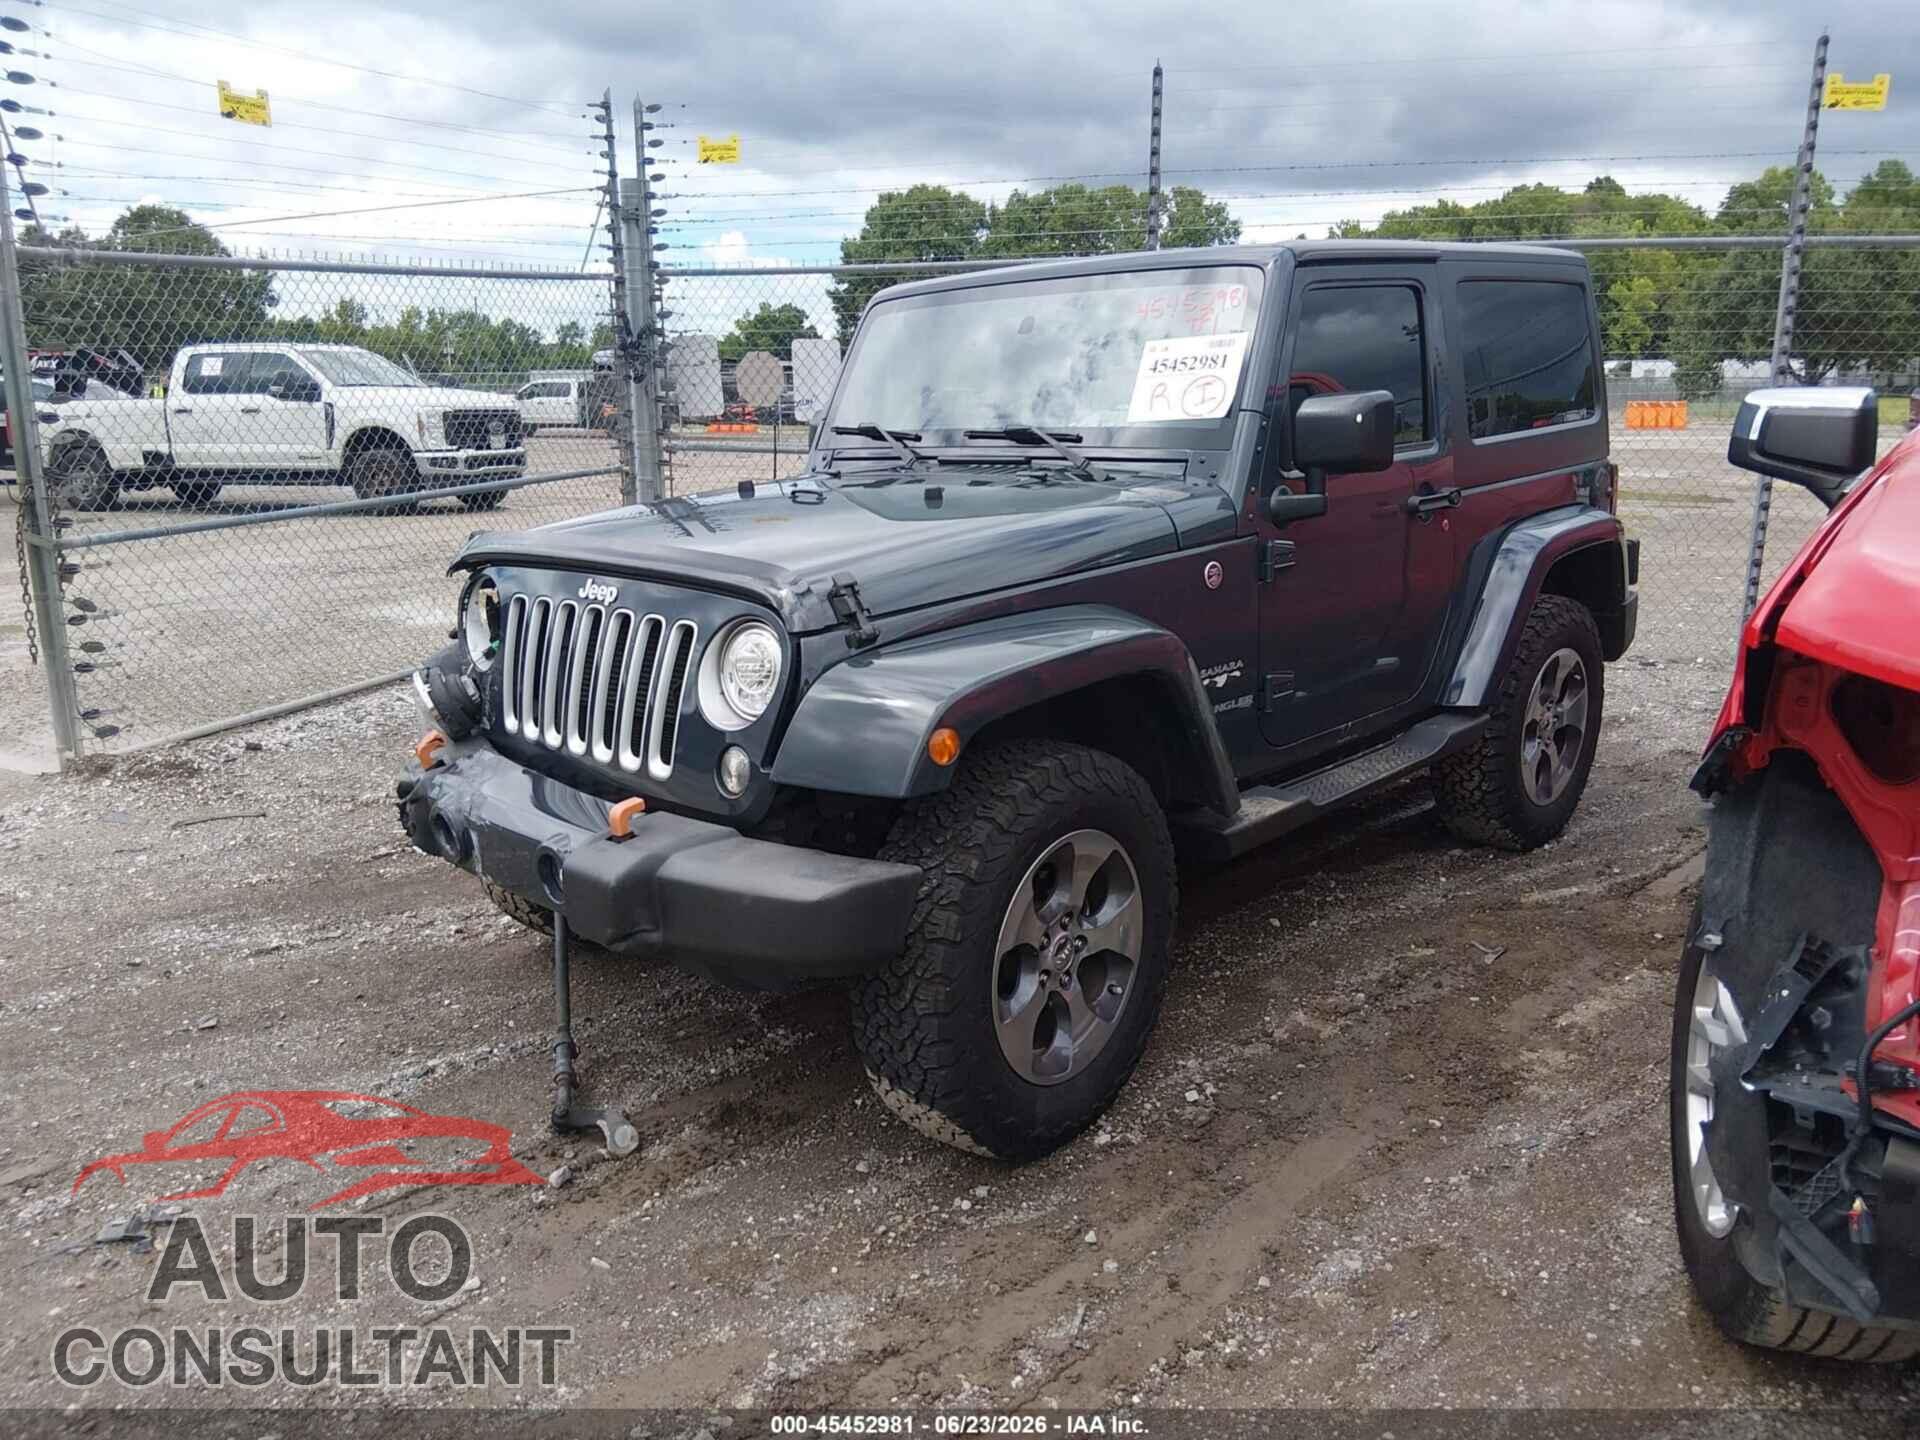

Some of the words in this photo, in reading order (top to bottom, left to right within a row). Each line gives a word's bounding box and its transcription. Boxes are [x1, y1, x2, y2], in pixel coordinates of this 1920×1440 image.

[1149, 354, 1228, 375] 45452981
[579, 578, 618, 606] Jeep
[1214, 695, 1254, 713] NGLER
